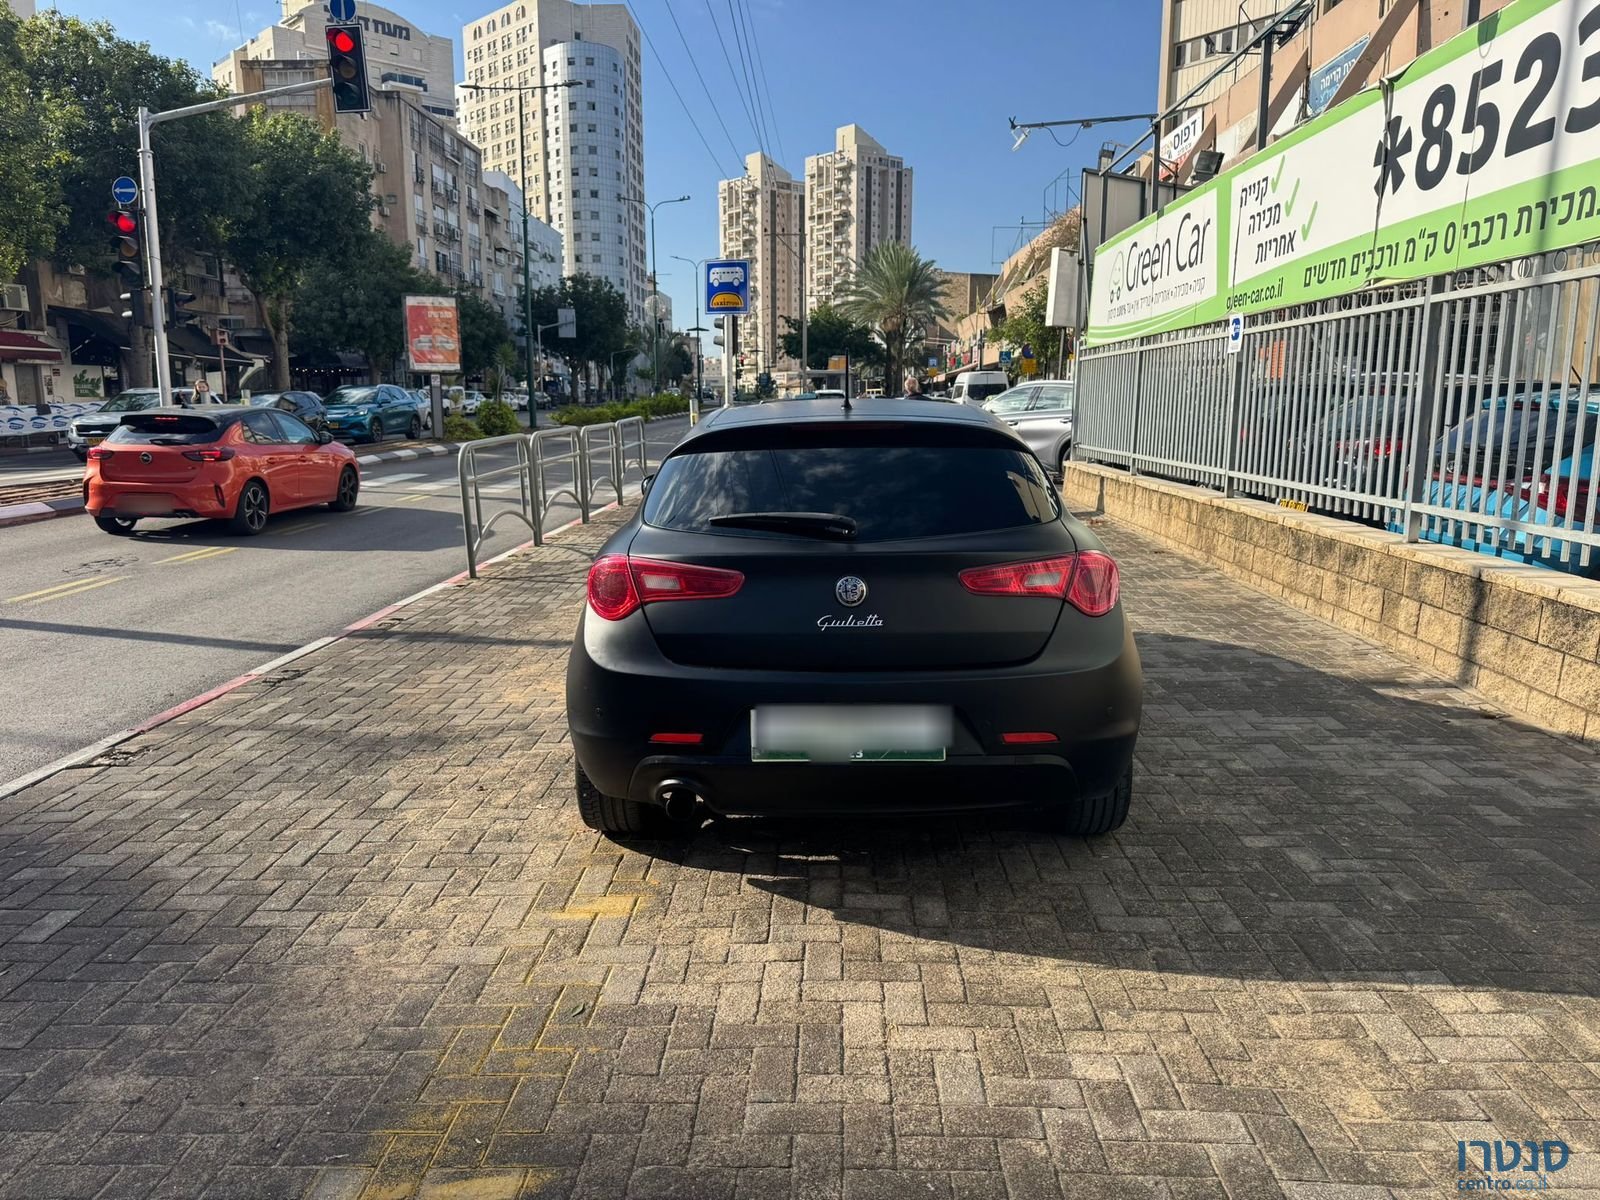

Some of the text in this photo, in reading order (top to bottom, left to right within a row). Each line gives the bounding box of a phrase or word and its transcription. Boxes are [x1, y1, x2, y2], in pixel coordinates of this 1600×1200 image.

[1173, 119, 1197, 150] דפוס
[1240, 176, 1269, 208] קנייה
[1248, 202, 1281, 235] מכירה
[1514, 185, 1600, 237] מכירת
[1255, 230, 1297, 264] אחריות
[1443, 221, 1457, 255] 0
[1462, 212, 1508, 249] רכבי
[1126, 212, 1211, 292] Green Car
[1303, 257, 1346, 288] חדשים
[816, 614, 884, 632] Giulietta
